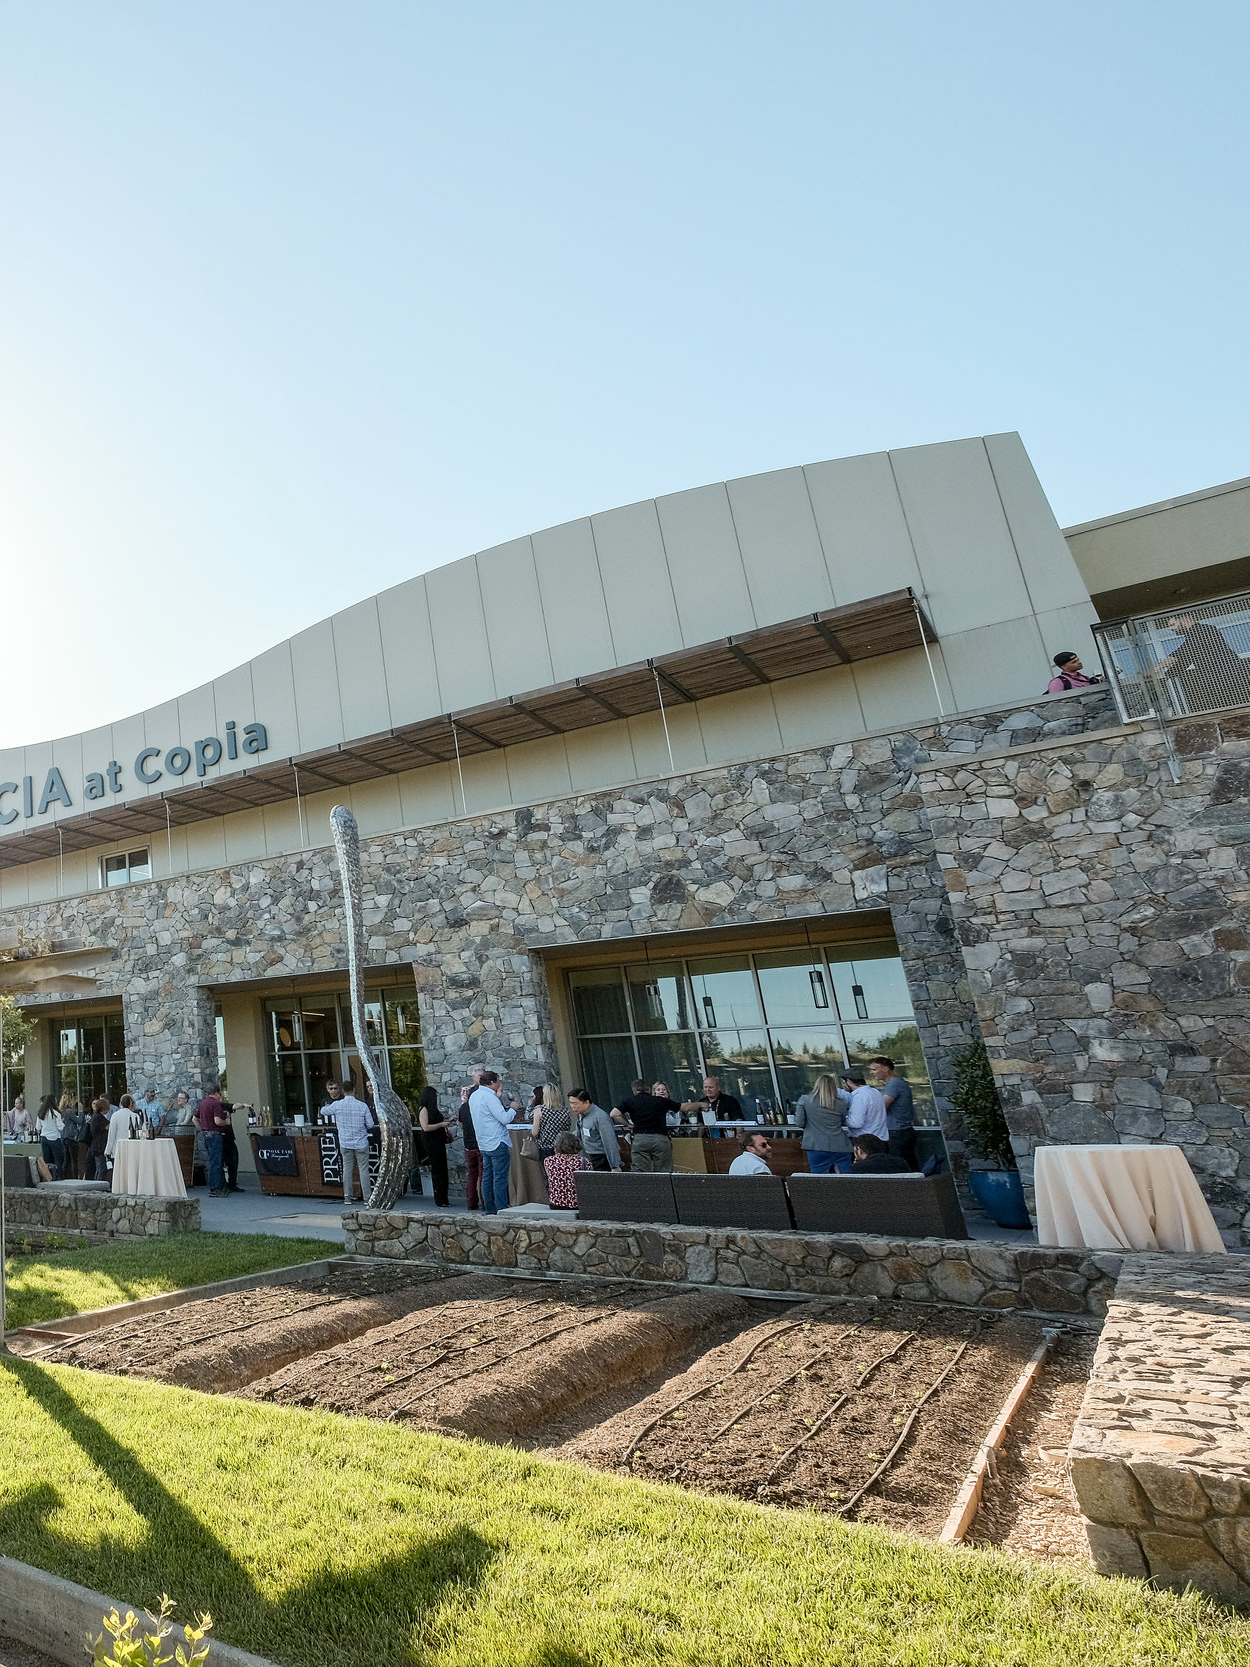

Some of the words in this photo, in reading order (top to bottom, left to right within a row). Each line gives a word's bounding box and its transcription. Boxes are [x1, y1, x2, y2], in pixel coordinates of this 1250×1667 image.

[84, 760, 122, 800] at
[134, 720, 268, 784] Copia
[321, 1137, 340, 1183] PRIE
